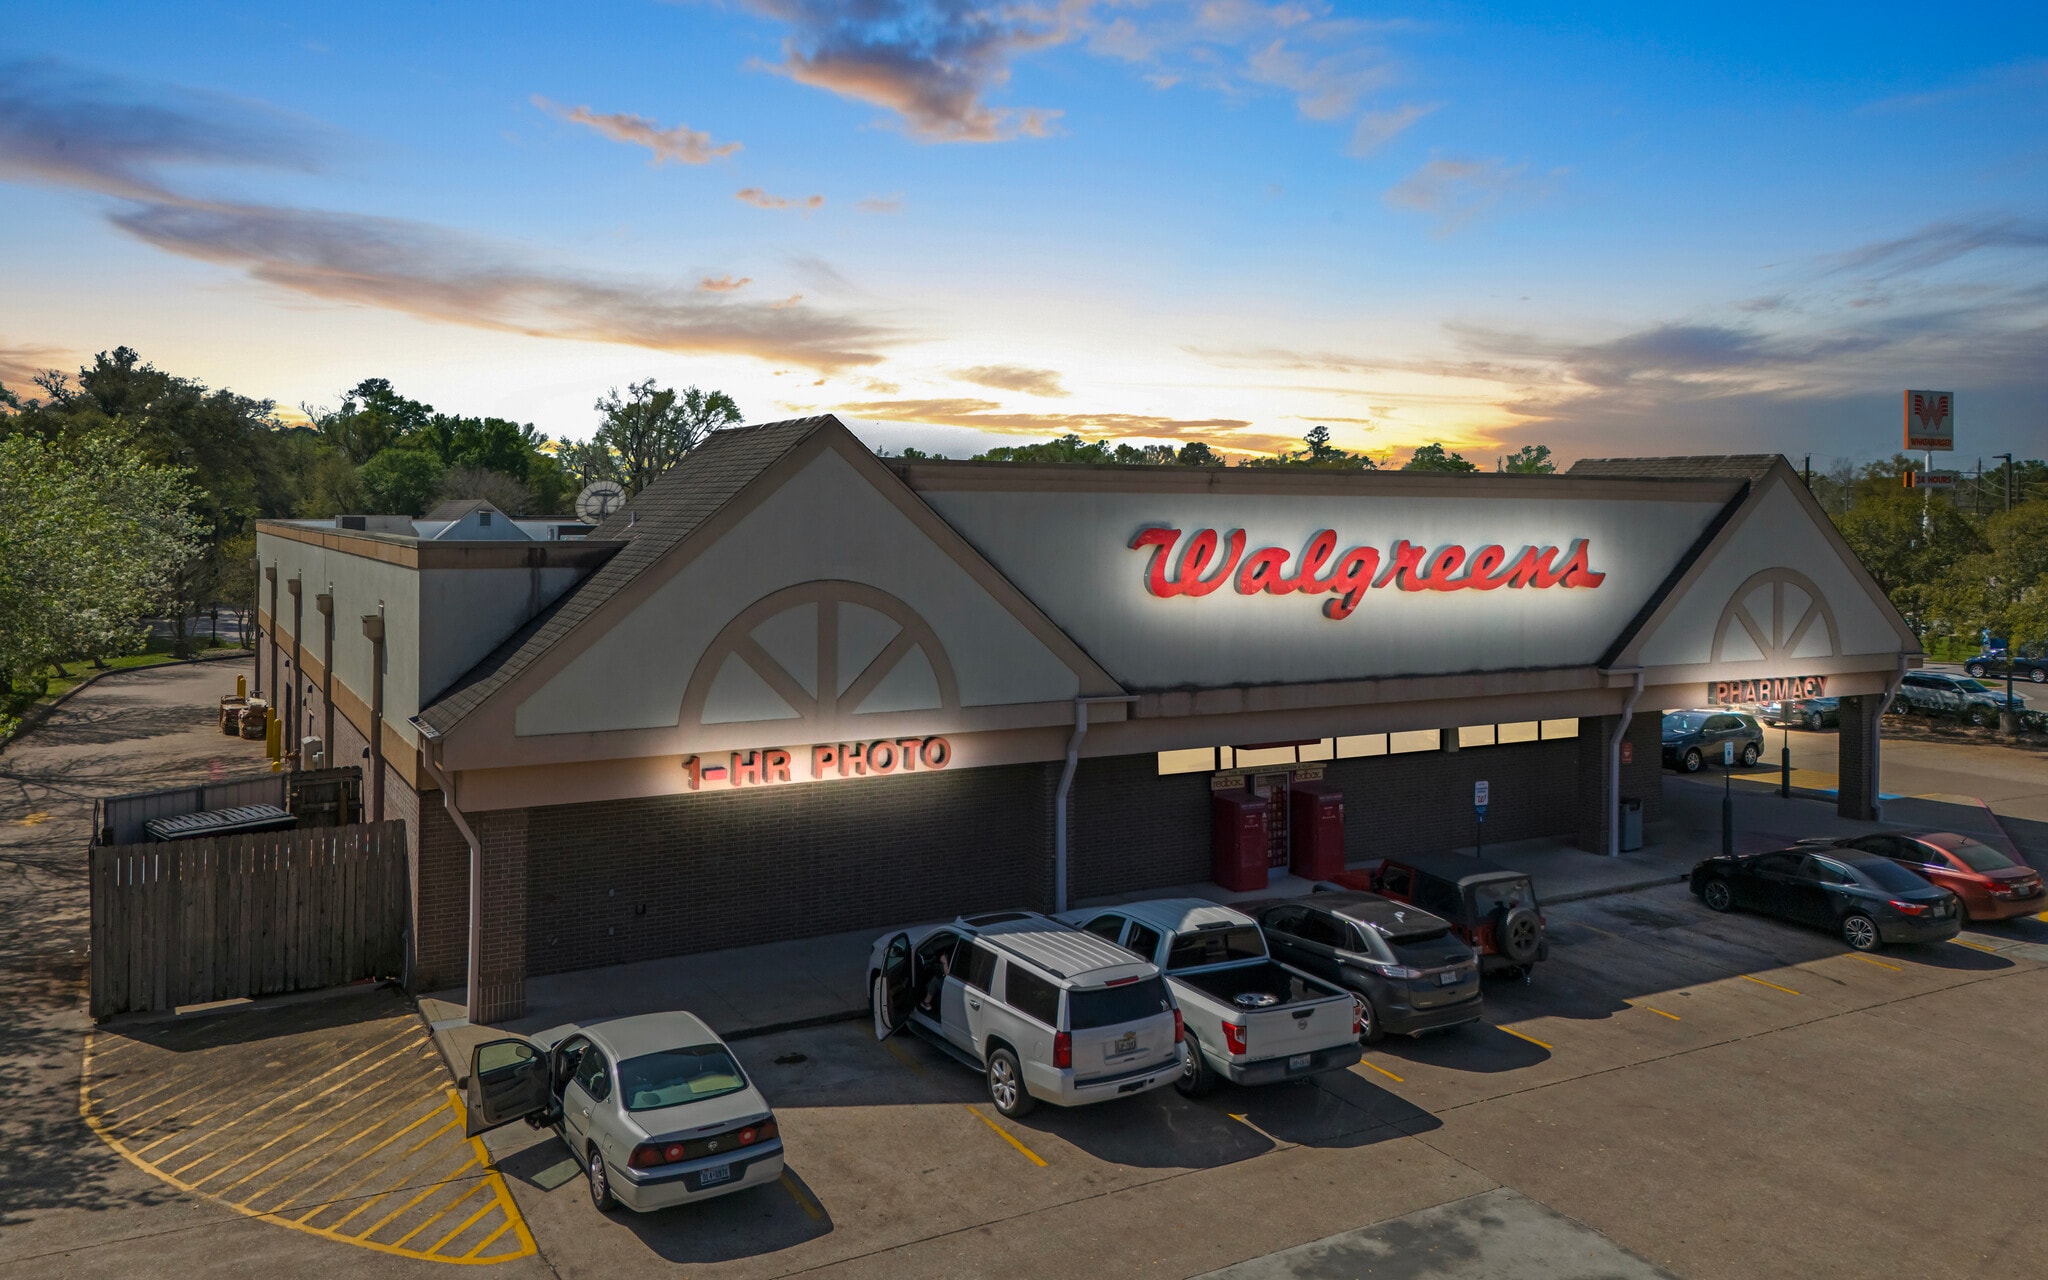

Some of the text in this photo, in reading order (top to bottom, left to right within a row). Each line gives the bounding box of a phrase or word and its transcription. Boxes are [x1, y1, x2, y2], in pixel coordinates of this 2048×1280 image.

[1910, 438, 1952, 447] WHATABURGER
[1916, 475, 1952, 485] 24 HOURS
[1128, 524, 1606, 620] Walgreens
[1716, 675, 1828, 705] PHARMACY
[682, 736, 952, 790] 1-HR PHOTO
